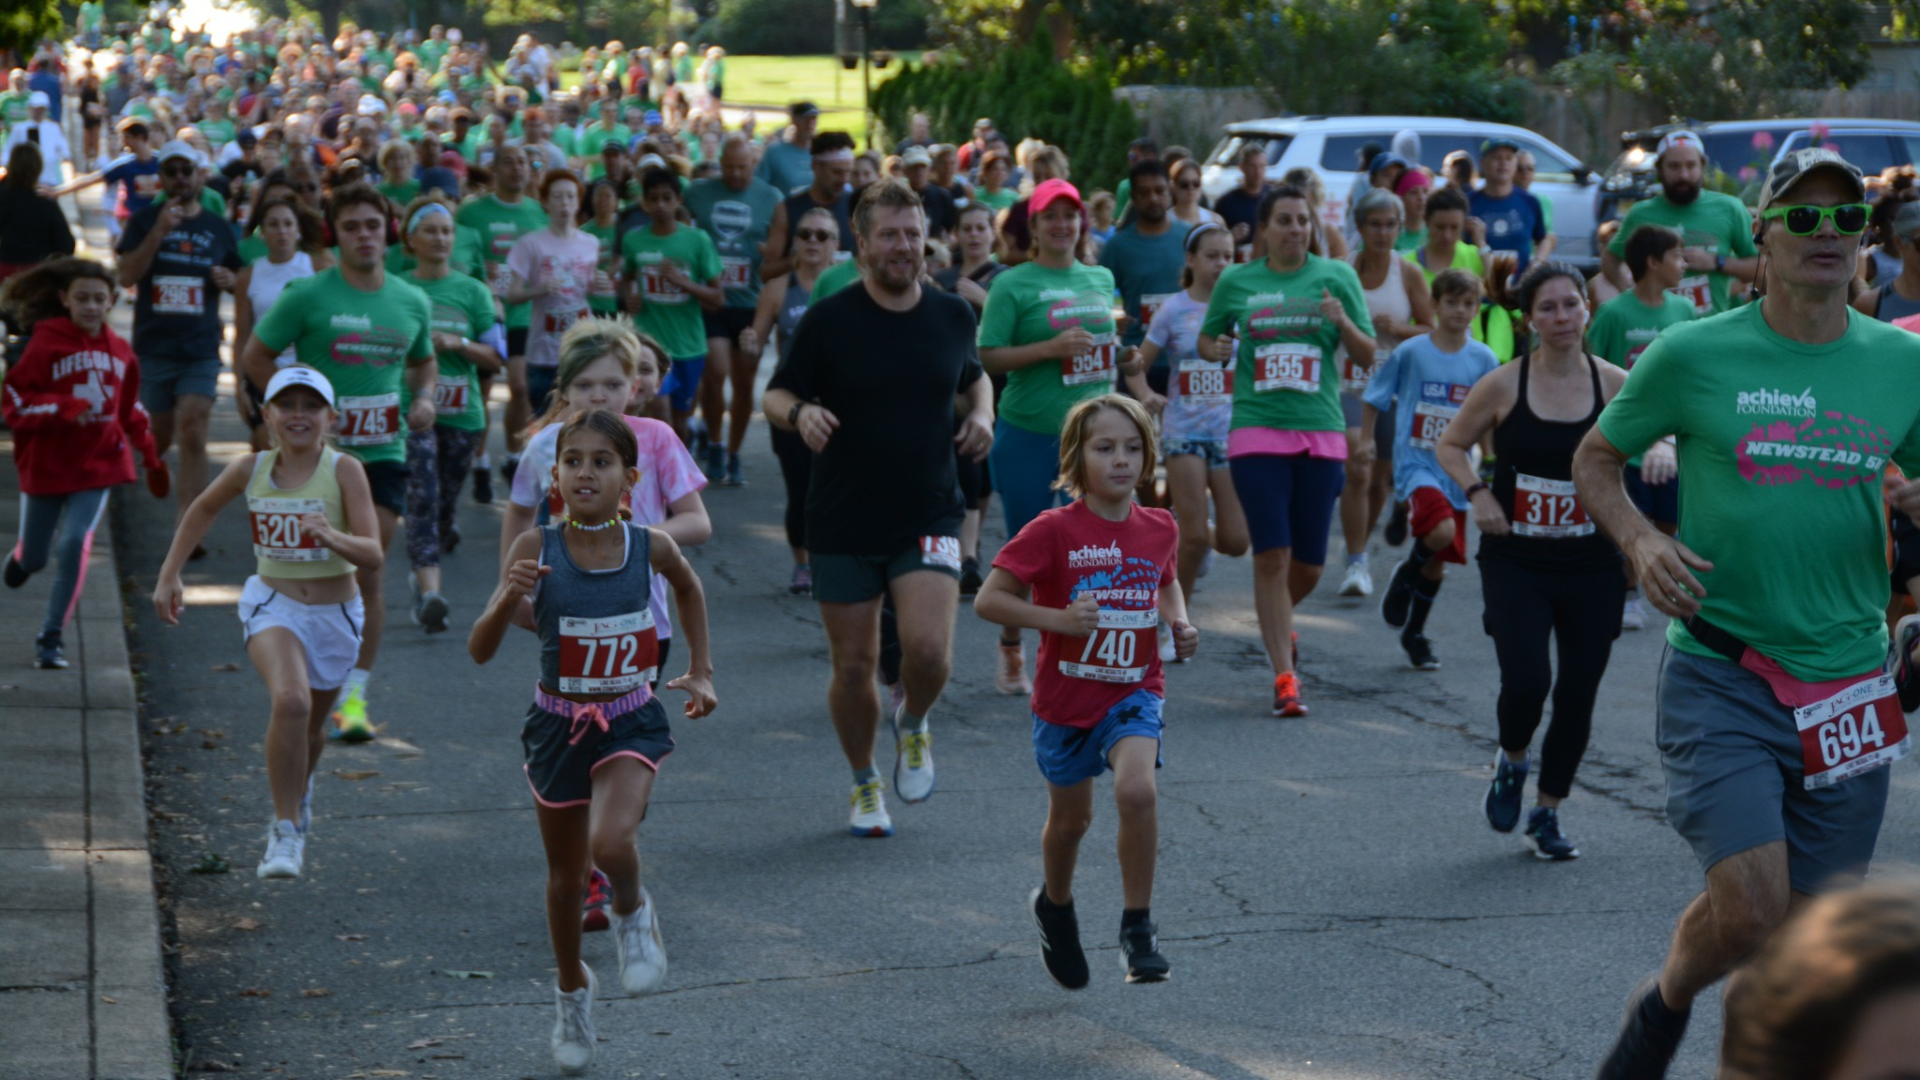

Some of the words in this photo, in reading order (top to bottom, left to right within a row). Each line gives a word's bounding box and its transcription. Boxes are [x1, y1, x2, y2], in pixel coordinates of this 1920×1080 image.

[158, 285, 190, 304] 296
[1265, 354, 1304, 379] 555
[1188, 371, 1225, 394] 688
[1422, 383, 1447, 398] USA
[434, 385, 457, 407] 07
[1737, 386, 1816, 408] achieve
[351, 408, 388, 435] 745
[1737, 404, 1816, 418] FOUNDATION
[1421, 415, 1449, 442] 68
[1745, 441, 1862, 465] NEWSTEAD
[1526, 492, 1576, 525] 312
[255, 513, 300, 548] 520
[1068, 539, 1122, 561] achieve
[1068, 558, 1123, 568] FOUNDATION
[577, 633, 638, 677] 772
[1080, 629, 1136, 667] 740
[541, 694, 573, 718] DER
[1818, 703, 1886, 767] 694
